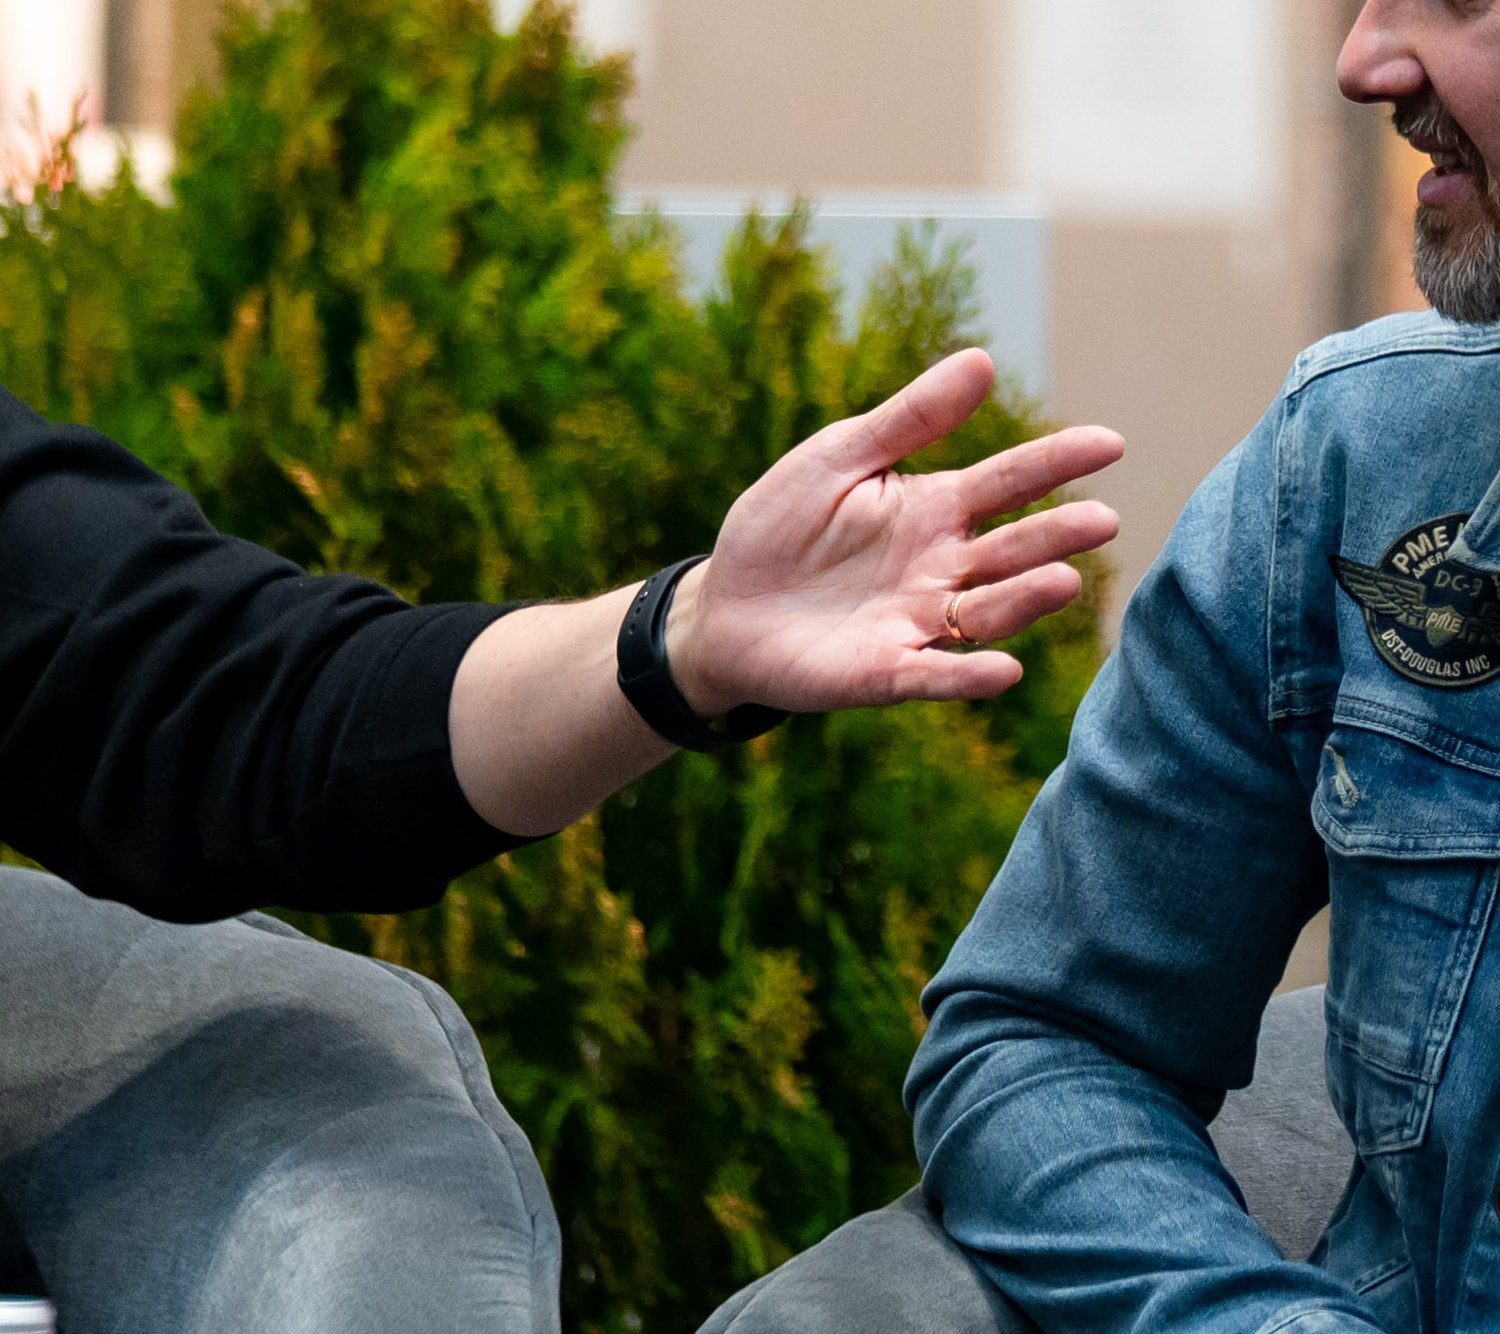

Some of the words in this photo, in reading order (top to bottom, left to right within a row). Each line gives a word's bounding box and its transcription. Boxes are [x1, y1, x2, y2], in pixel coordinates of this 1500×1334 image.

[1392, 525, 1449, 575] PME
[1426, 612, 1463, 633] PME
[1381, 629, 1461, 677] DST-DOUGLAS
[1465, 654, 1490, 674] INC
